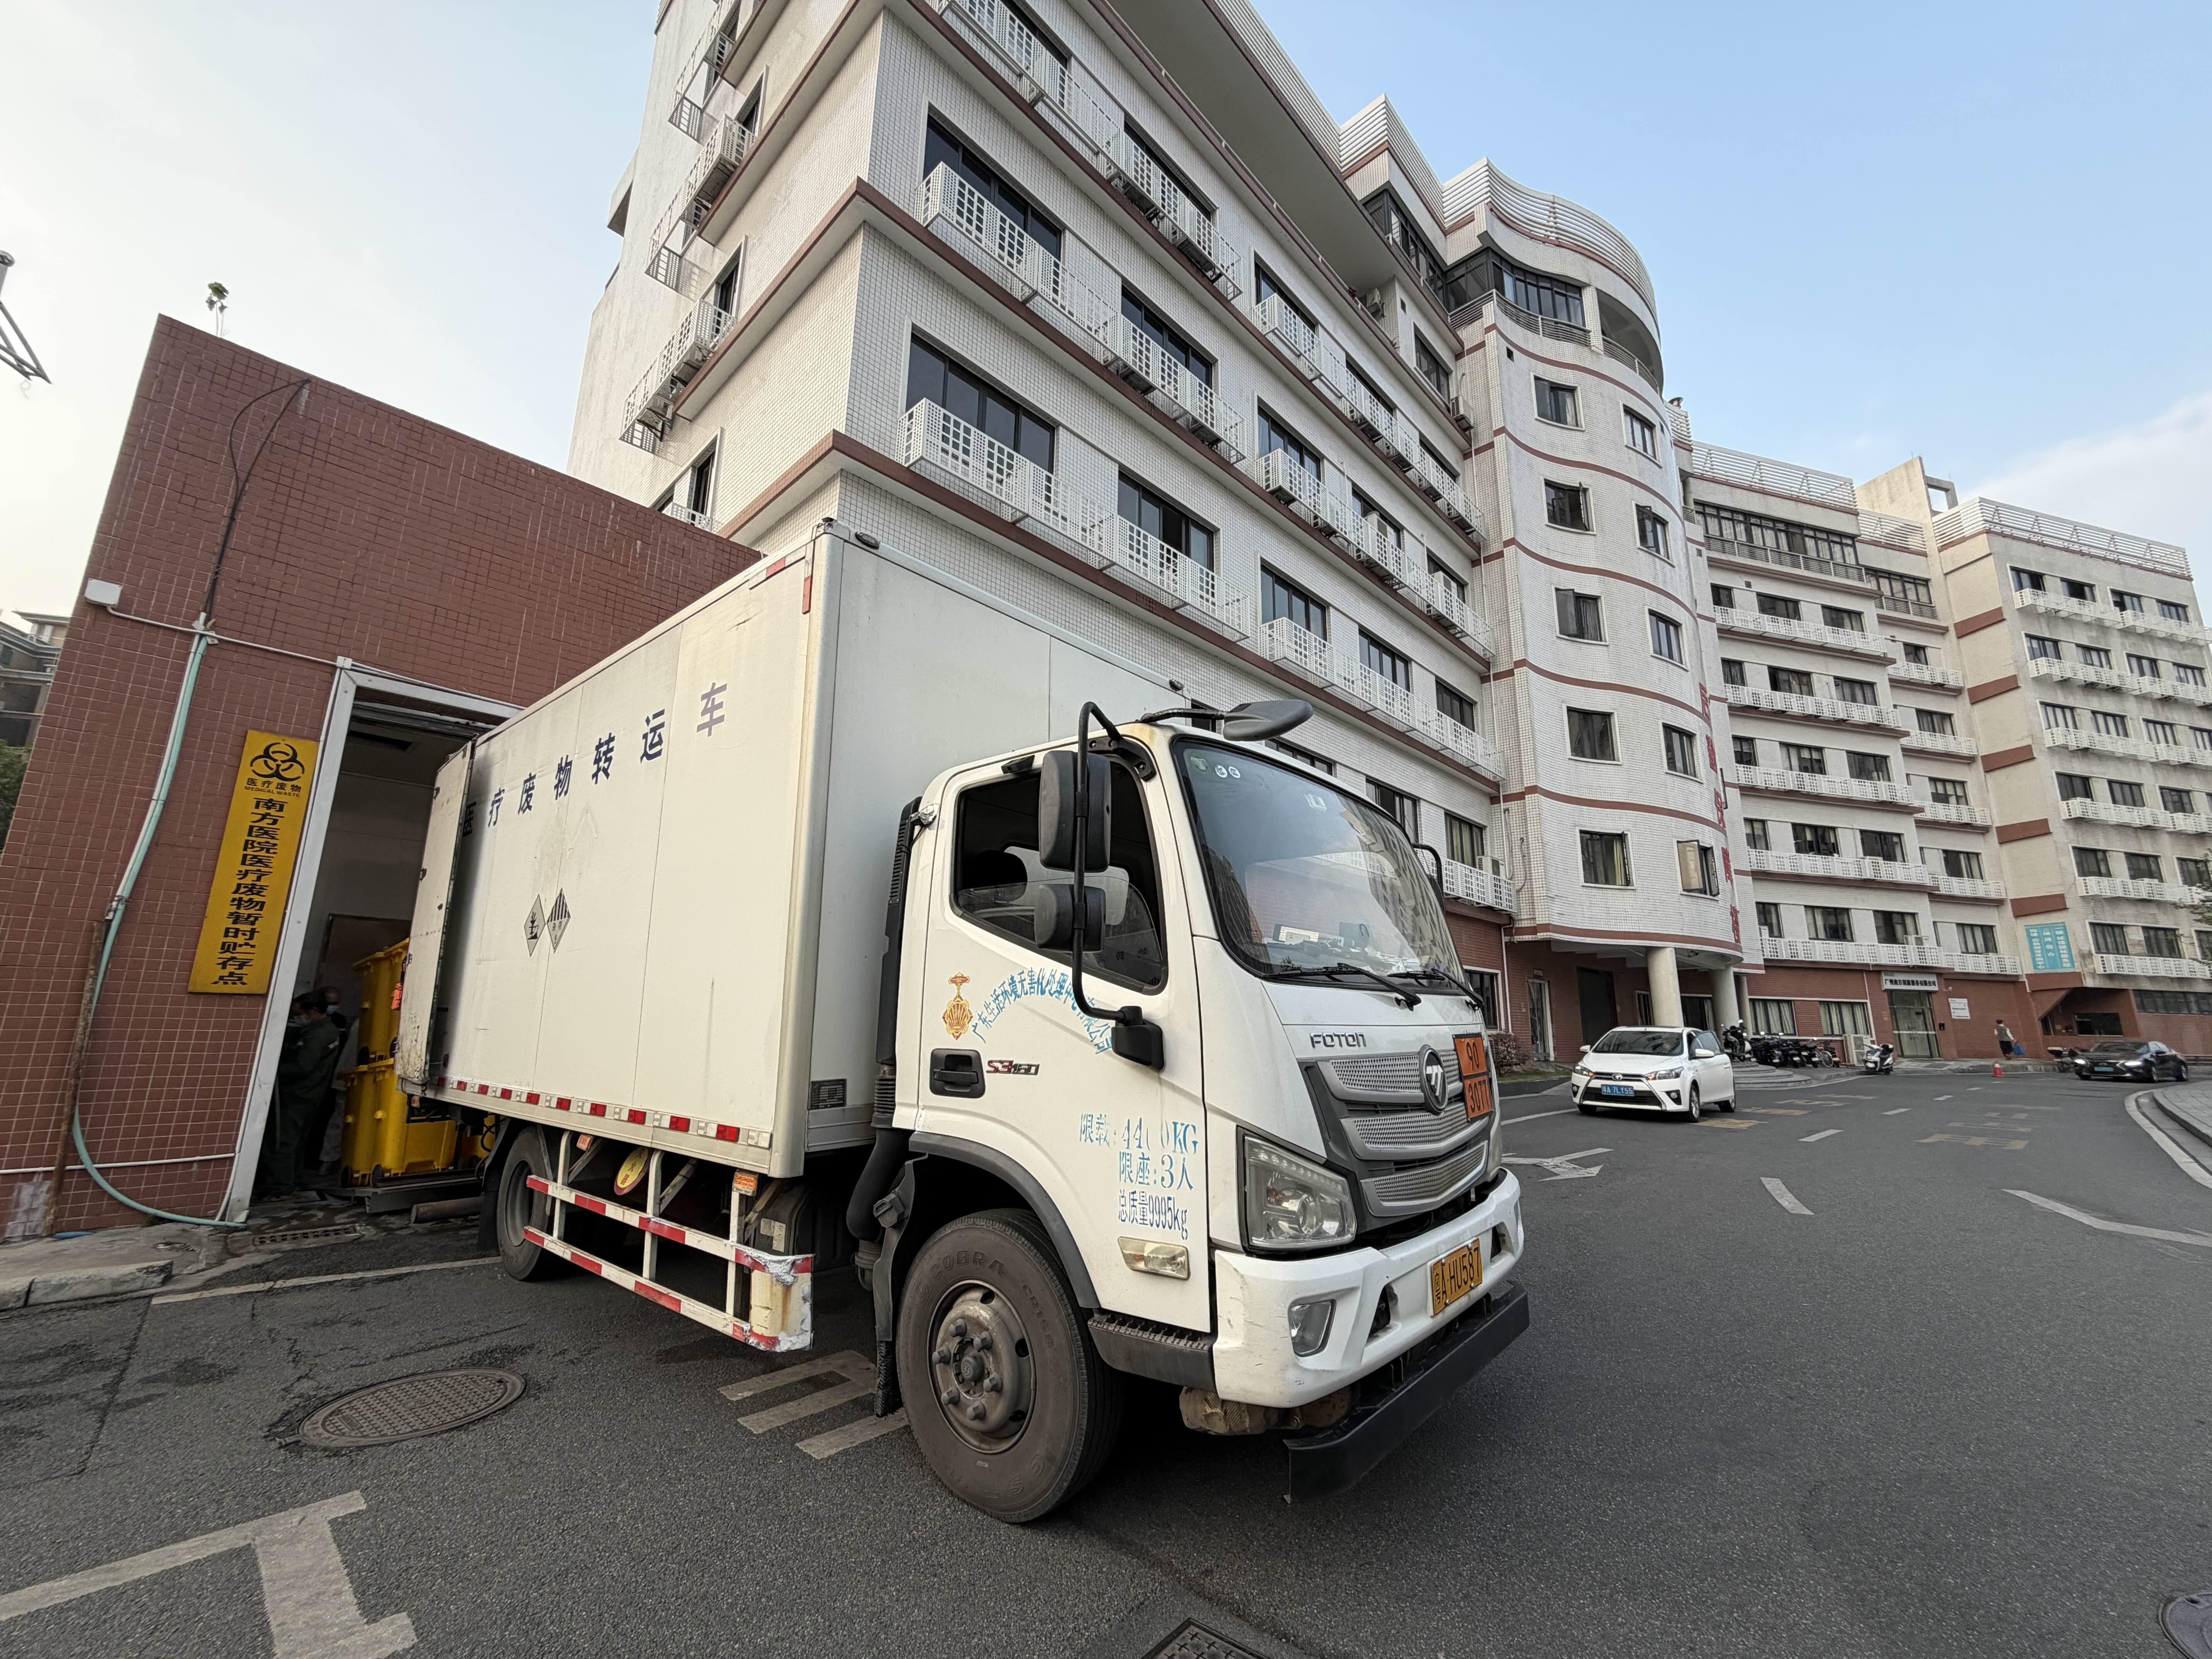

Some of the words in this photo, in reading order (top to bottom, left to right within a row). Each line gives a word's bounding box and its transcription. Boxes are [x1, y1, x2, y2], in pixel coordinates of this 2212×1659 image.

[463, 682, 727, 837] 医疗废物转运车
[247, 778, 301, 792] 医疗废物
[211, 797, 289, 986] 南方医院医疗废物暂时贮存点
[972, 967, 1112, 1054] 广东生活环境无害化处理中限公司
[1466, 1041, 1479, 1070] 90
[1468, 1079, 1489, 1113] 3077
[930, 1250, 1005, 1279] COBRA
